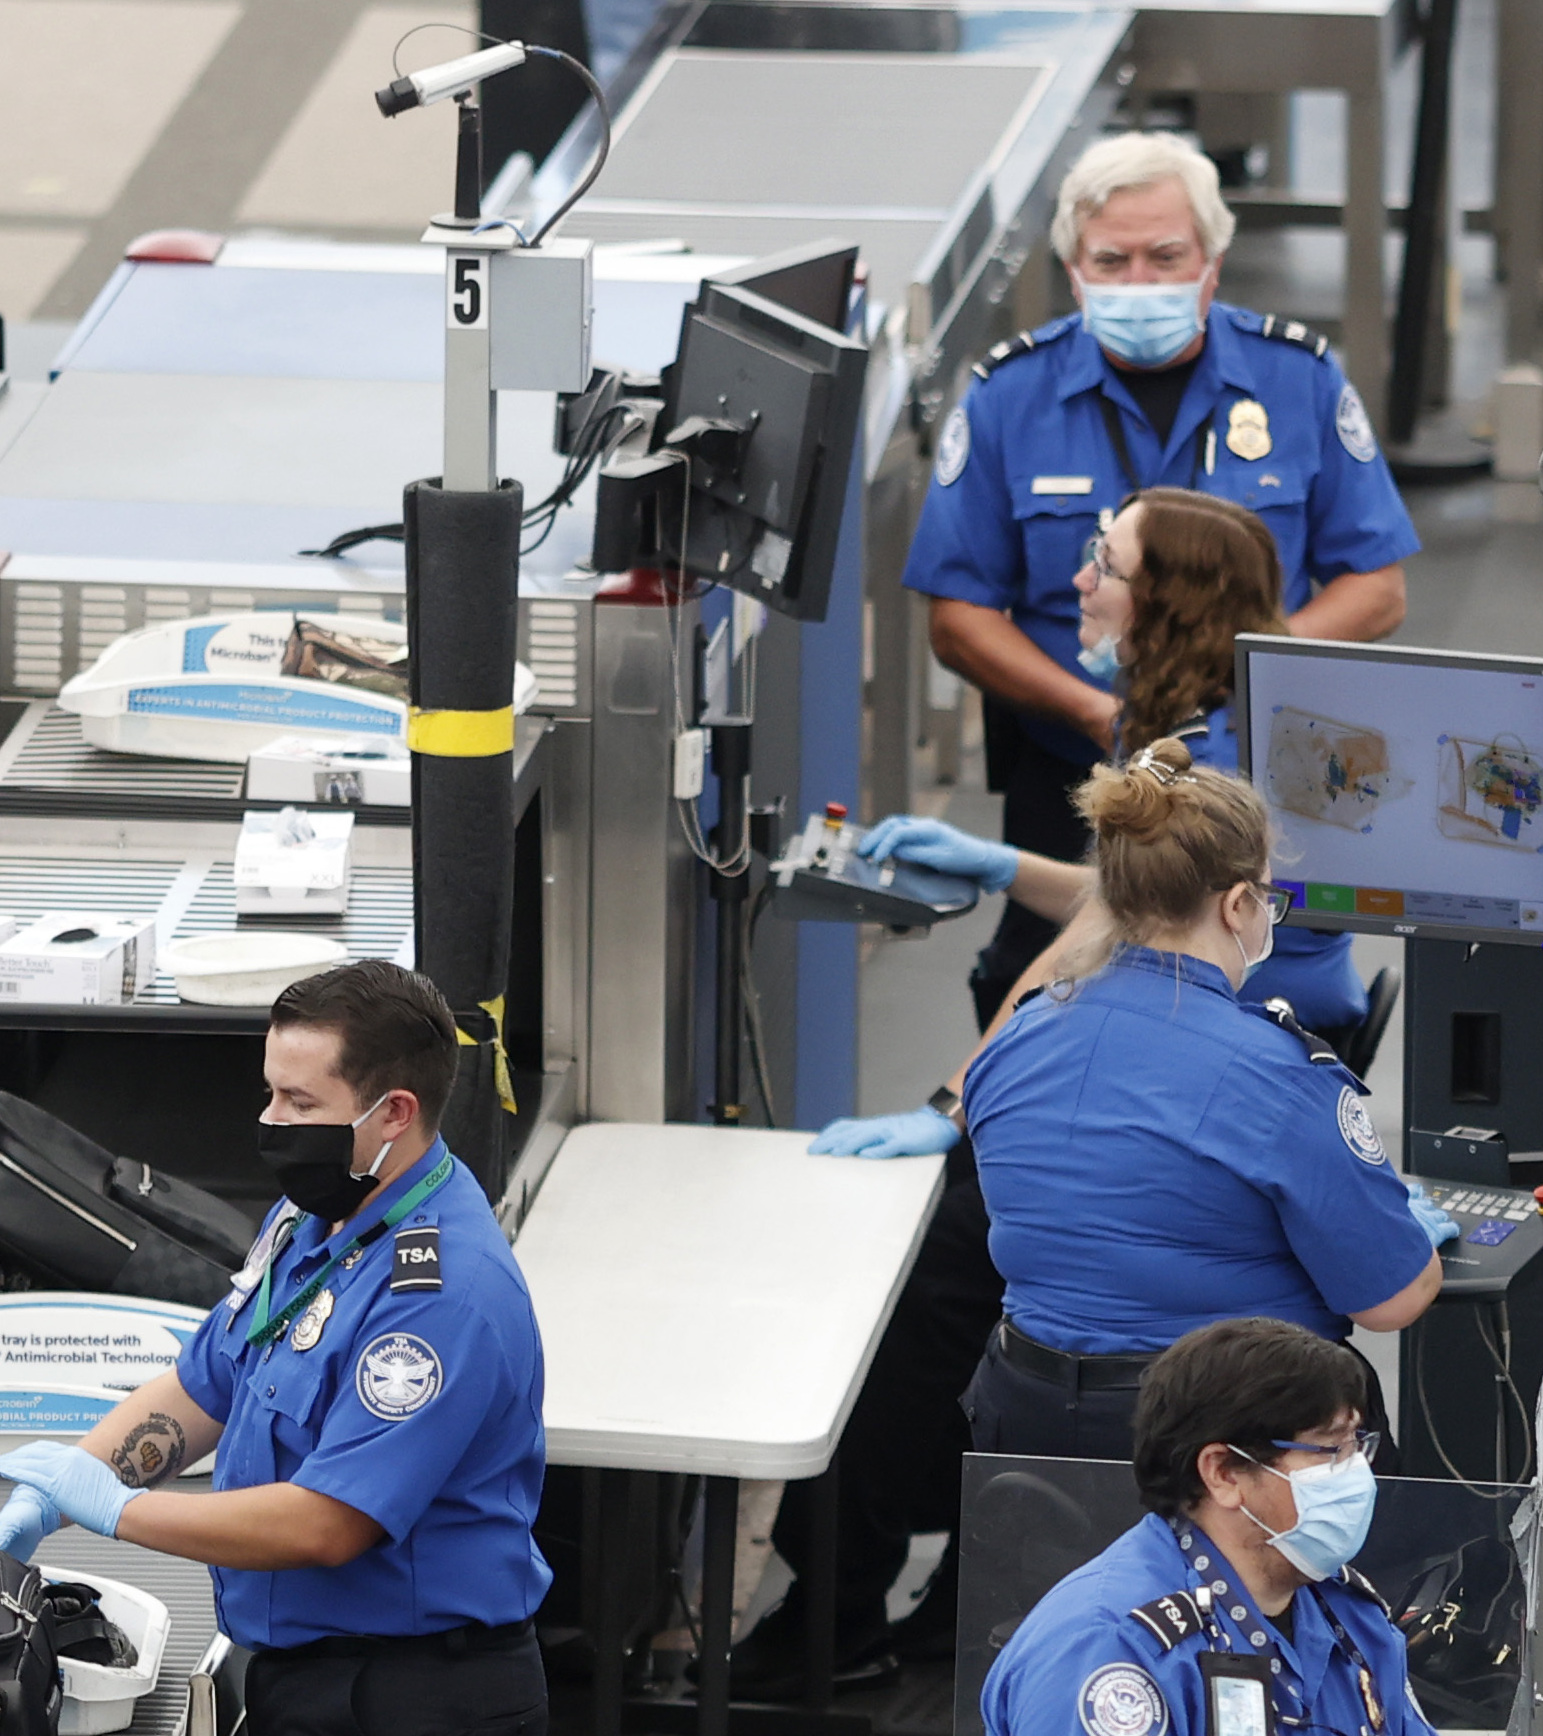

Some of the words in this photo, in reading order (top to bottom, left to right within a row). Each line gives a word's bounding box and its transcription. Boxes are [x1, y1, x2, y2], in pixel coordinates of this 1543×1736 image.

[453, 258, 482, 325] 5
[249, 634, 272, 647] This
[1394, 924, 1418, 934] acer
[398, 1248, 438, 1264] TSA
[2, 1335, 28, 1350] tray
[30, 1335, 41, 1347] is
[45, 1335, 109, 1349] protected
[112, 1335, 142, 1347] with
[5, 1350, 98, 1364] Antimicrobial
[29, 1412, 81, 1422] PRODUCT
[1158, 1597, 1188, 1635] TSA
